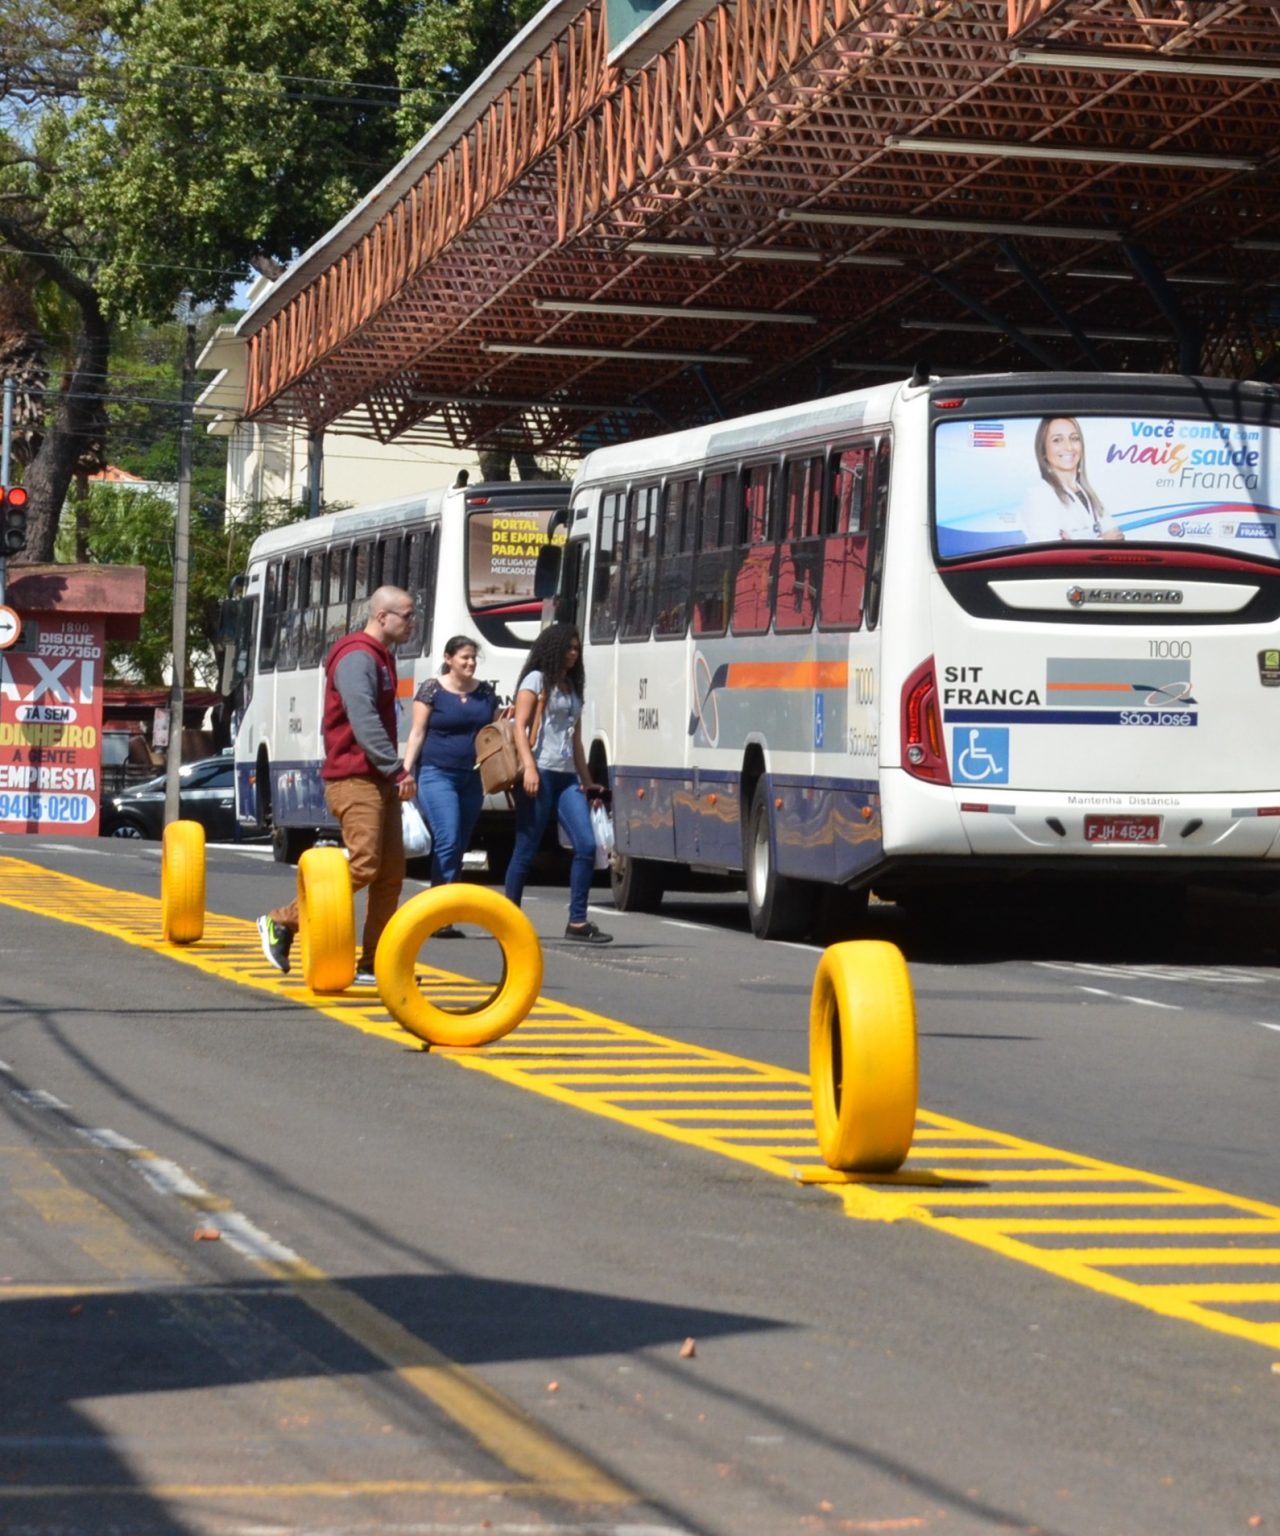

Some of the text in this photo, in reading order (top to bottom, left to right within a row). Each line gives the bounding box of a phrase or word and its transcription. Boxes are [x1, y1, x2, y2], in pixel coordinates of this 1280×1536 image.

[1131, 419, 1260, 440] Você conta com
[1106, 441, 1260, 474] mais saúde
[1156, 467, 1260, 490] em Franca
[492, 518, 540, 531] PORTAL
[492, 531, 508, 543] DE
[491, 544, 524, 556] PARA
[491, 558, 506, 567] QUE
[507, 559, 523, 568] LIGA
[491, 566, 526, 575] MERCADO
[40, 633, 95, 645] DISQUE
[38, 644, 101, 658] 3723-7360
[1149, 641, 1192, 658] 11000
[945, 666, 983, 682] SIT
[639, 678, 648, 700] SIT
[944, 688, 1041, 706] FRANCA
[44, 707, 70, 720] SEM
[1120, 711, 1191, 727] São José
[0, 723, 97, 749] DINHEIRO
[12, 749, 76, 764] A GENTE
[0, 765, 96, 791] EMPRESTA
[1067, 796, 1180, 806] Mantenha Distância
